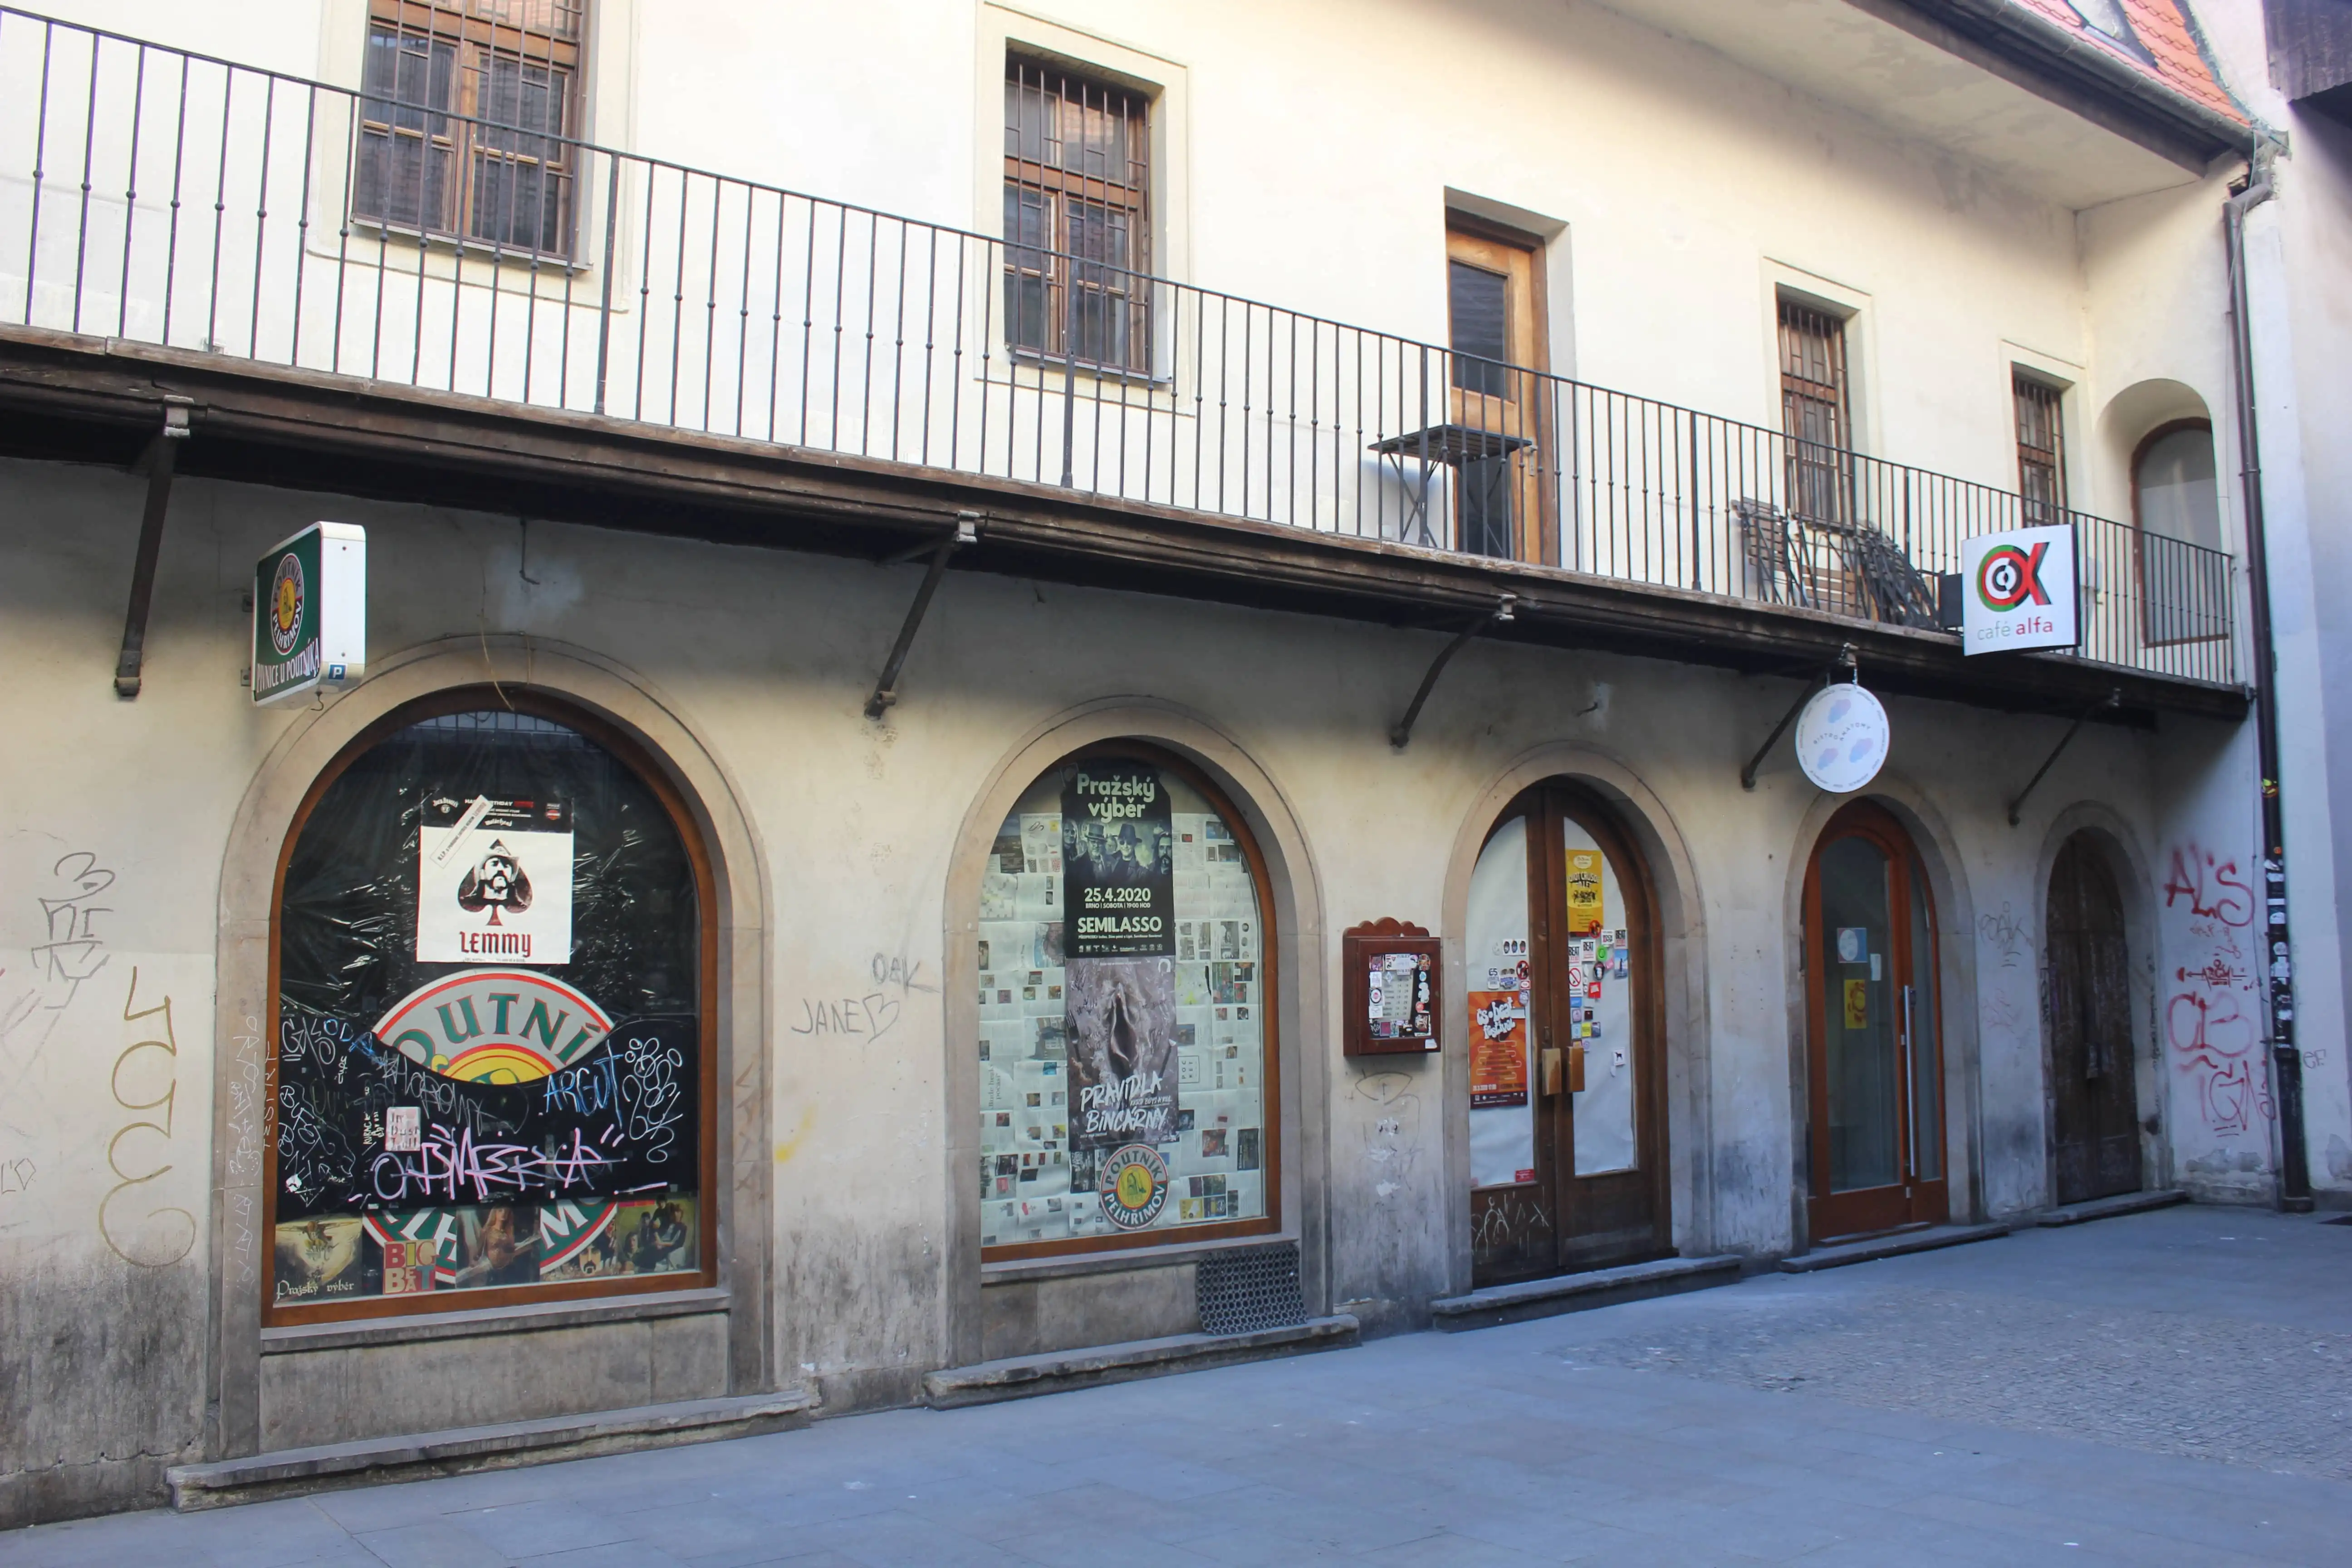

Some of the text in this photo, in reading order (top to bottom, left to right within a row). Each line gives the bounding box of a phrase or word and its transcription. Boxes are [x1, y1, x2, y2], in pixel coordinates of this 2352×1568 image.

[272, 600, 302, 649] PELHŘIMOV
[1977, 616, 2053, 640] café alfa
[257, 637, 320, 693] PIVNICE U POUTNÍKA
[333, 667, 342, 678] P
[1077, 774, 1154, 803] Pražský
[1088, 797, 1146, 823] výběr
[1084, 887, 1151, 902] 25.4.2020
[1078, 916, 1162, 933] SEMILASSO
[392, 992, 602, 1067] OUTNÍ
[791, 998, 863, 1035] JANE
[1105, 1150, 1162, 1186] POUTNÍK
[1104, 1185, 1165, 1225] PELHŘIMOV
[386, 1241, 436, 1268] BIG
